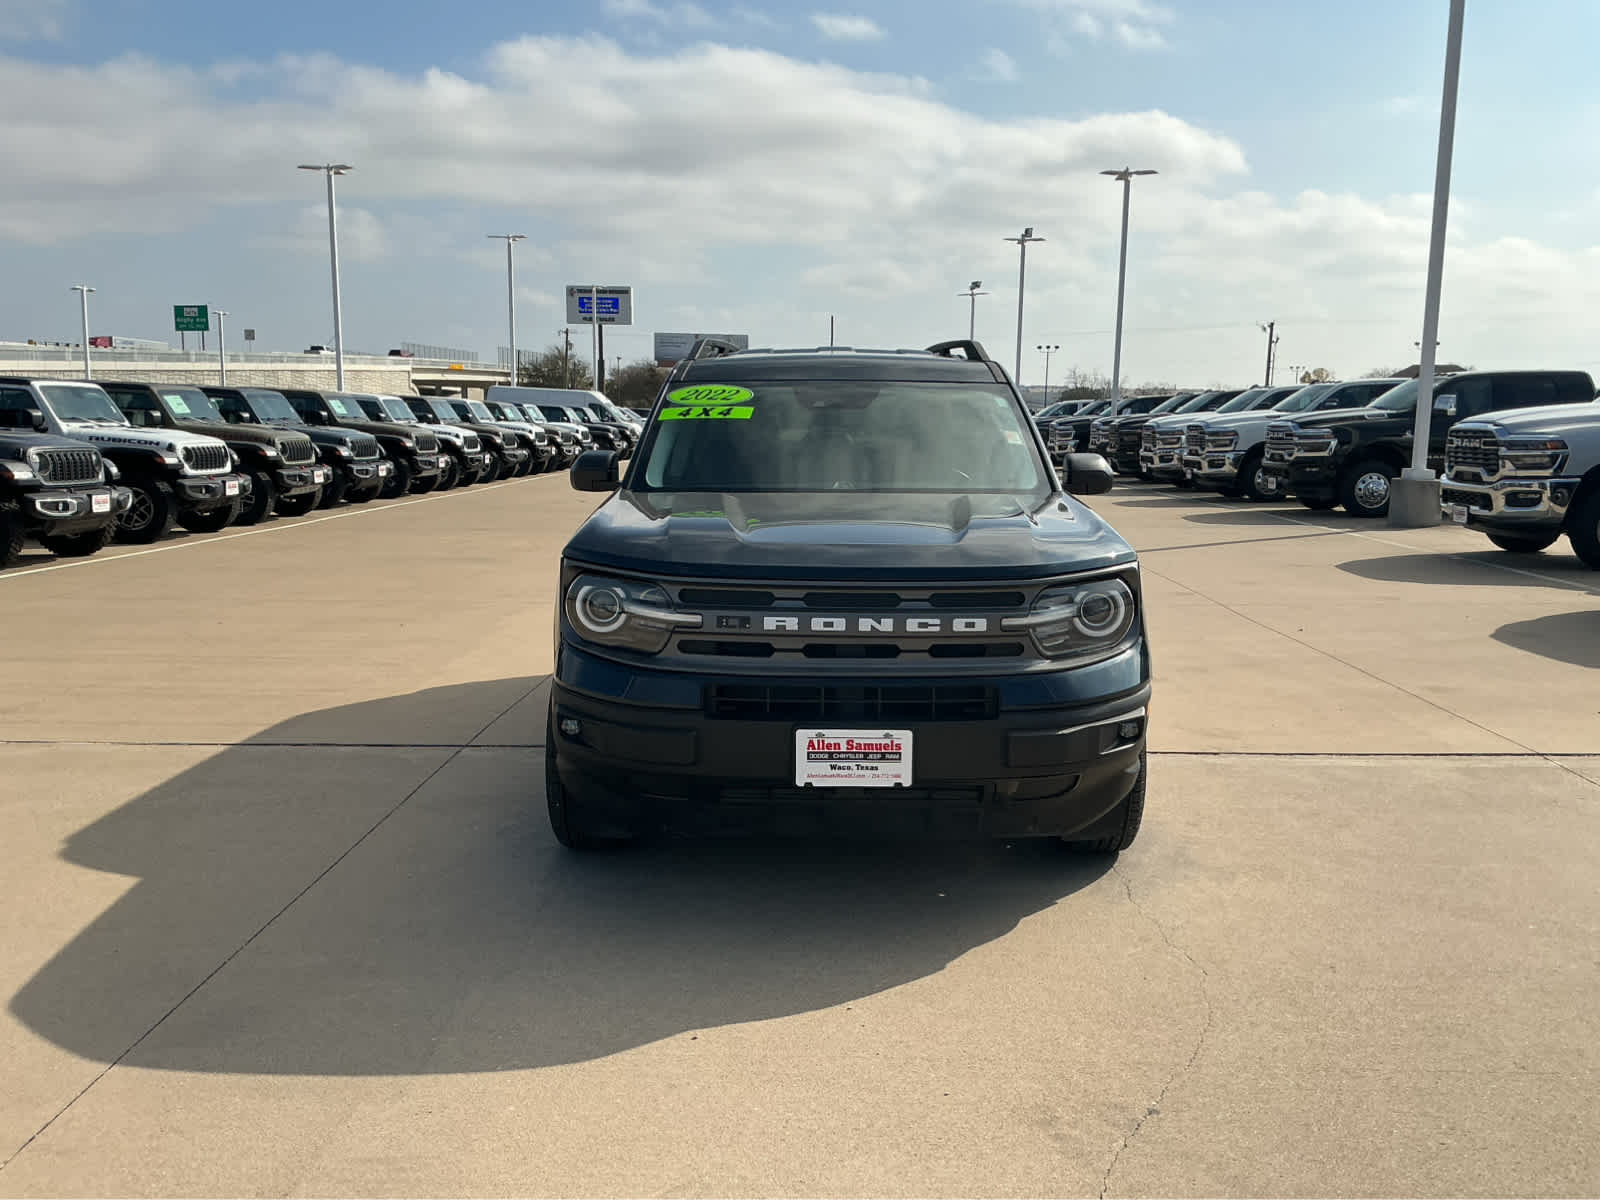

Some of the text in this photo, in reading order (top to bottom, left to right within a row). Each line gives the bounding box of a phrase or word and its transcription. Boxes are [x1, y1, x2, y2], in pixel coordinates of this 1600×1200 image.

[680, 389, 741, 401] 2022
[88, 435, 161, 447] RUBICON
[1455, 438, 1481, 447] RAM
[716, 615, 988, 632] RONCO
[807, 739, 902, 752] Allen Samuels
